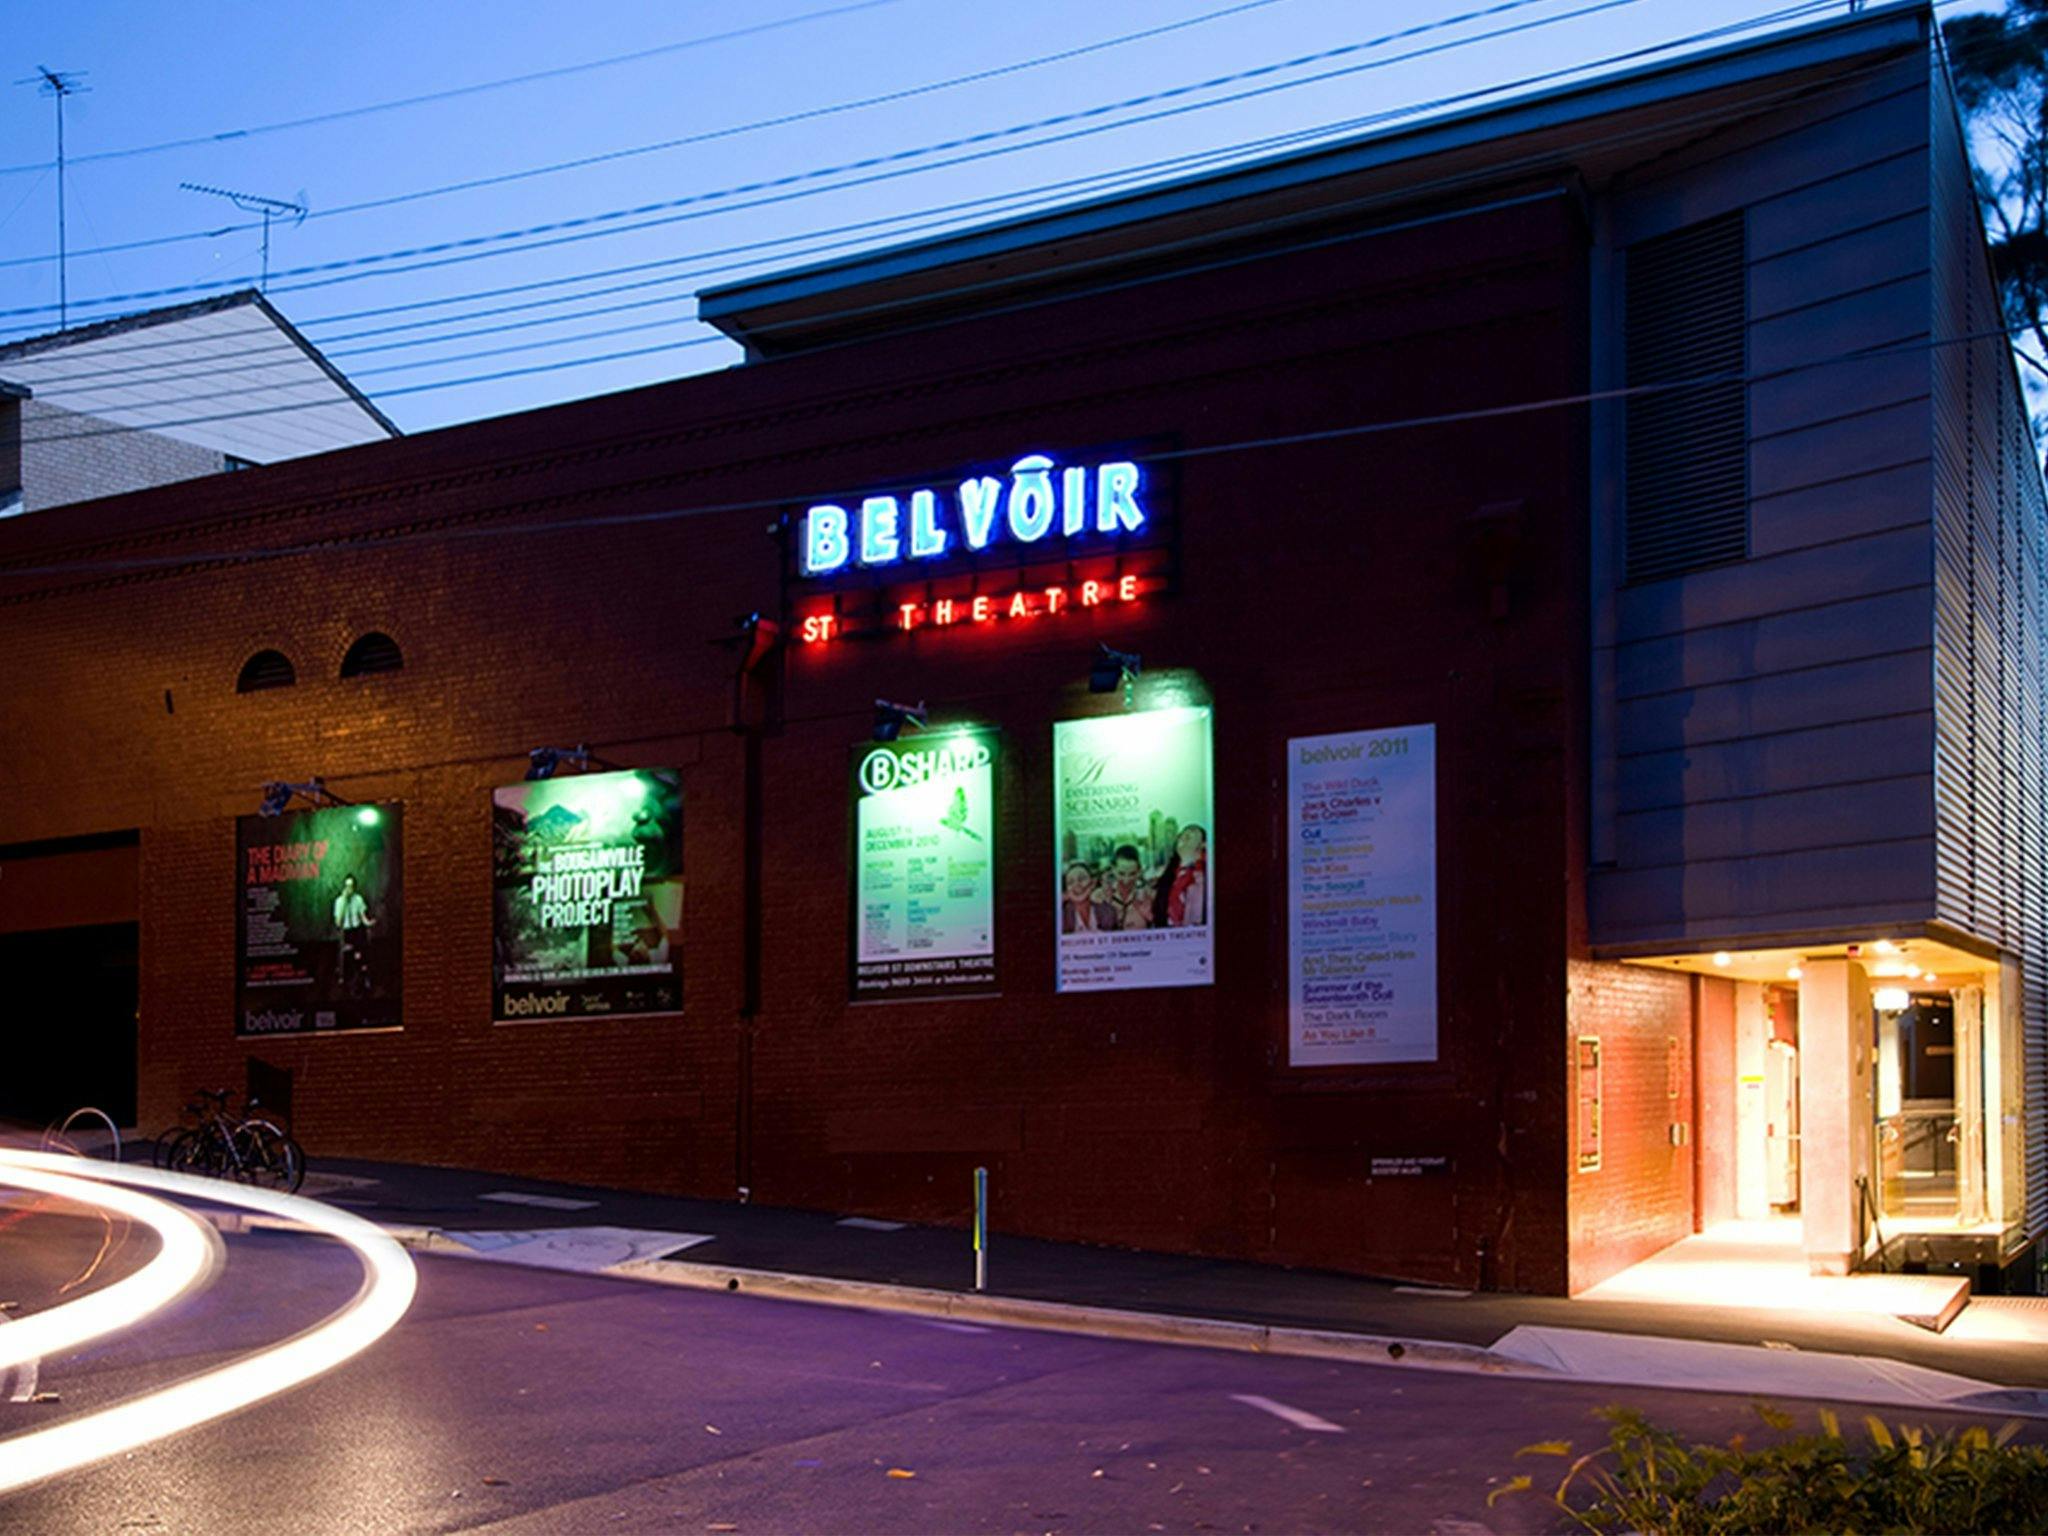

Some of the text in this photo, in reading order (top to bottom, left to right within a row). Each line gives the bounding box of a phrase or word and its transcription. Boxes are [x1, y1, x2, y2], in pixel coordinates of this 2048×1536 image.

[803, 576, 1137, 642] ST THEATRE
[1300, 736, 1409, 765] belvoir 2011
[1302, 781, 1322, 791] The
[1350, 776, 1379, 788] Duck
[1065, 796, 1140, 815] SCENARIO
[1302, 799, 1327, 811] Jack
[1329, 796, 1372, 809] Charles
[1301, 811, 1319, 822] the
[1321, 808, 1359, 820] Crown
[1301, 828, 1322, 839] Cut
[865, 839, 912, 852] DECEMBER
[1302, 864, 1322, 874] The
[532, 867, 645, 904] PHOTOPLAY
[1302, 879, 1365, 893] The Seagull
[541, 898, 612, 928] PROJECT
[1301, 915, 1379, 929] Windmill Baby
[1111, 932, 1166, 945] DOWNSTAIRS
[1168, 929, 1207, 940] THEATRE
[1388, 931, 1418, 943] Story
[958, 957, 994, 969] THEATRE
[1302, 955, 1325, 966] And
[1328, 952, 1352, 965] They
[1355, 951, 1391, 962] Called
[1302, 980, 1384, 993] Summer of the
[503, 990, 571, 1015] belvoir
[245, 1009, 304, 1030] belvoir
[1303, 1009, 1389, 1022] The Dark Room
[1302, 1027, 1376, 1041] As You Like It
